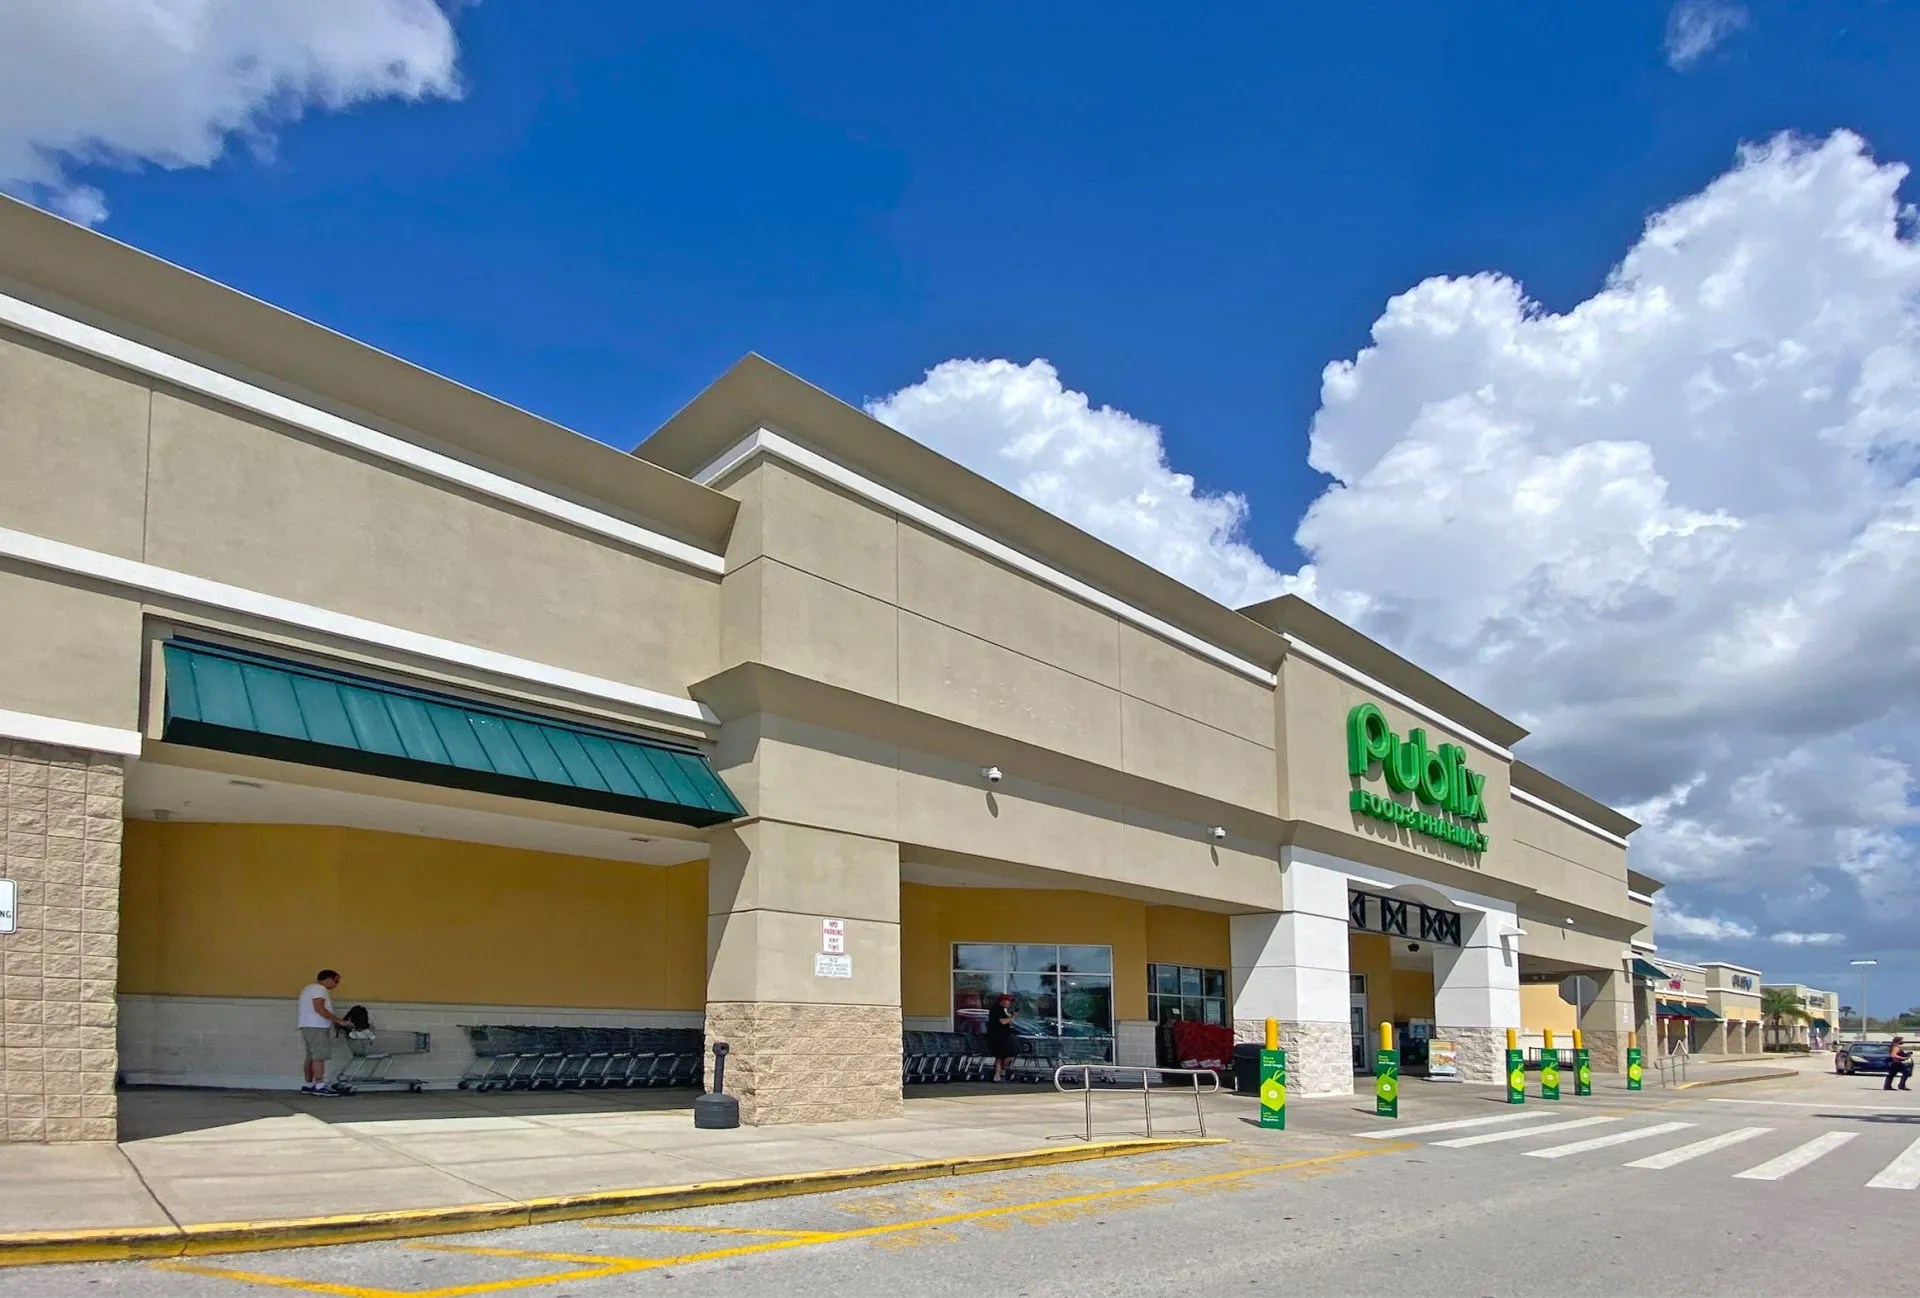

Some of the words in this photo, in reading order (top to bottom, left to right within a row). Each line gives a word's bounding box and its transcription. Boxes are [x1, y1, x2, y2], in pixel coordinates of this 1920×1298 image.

[1347, 702, 1488, 823] Publix
[1350, 789, 1404, 822] FOOD
[1419, 811, 1489, 852] PHARMACY
[824, 928, 843, 936] PARKING
